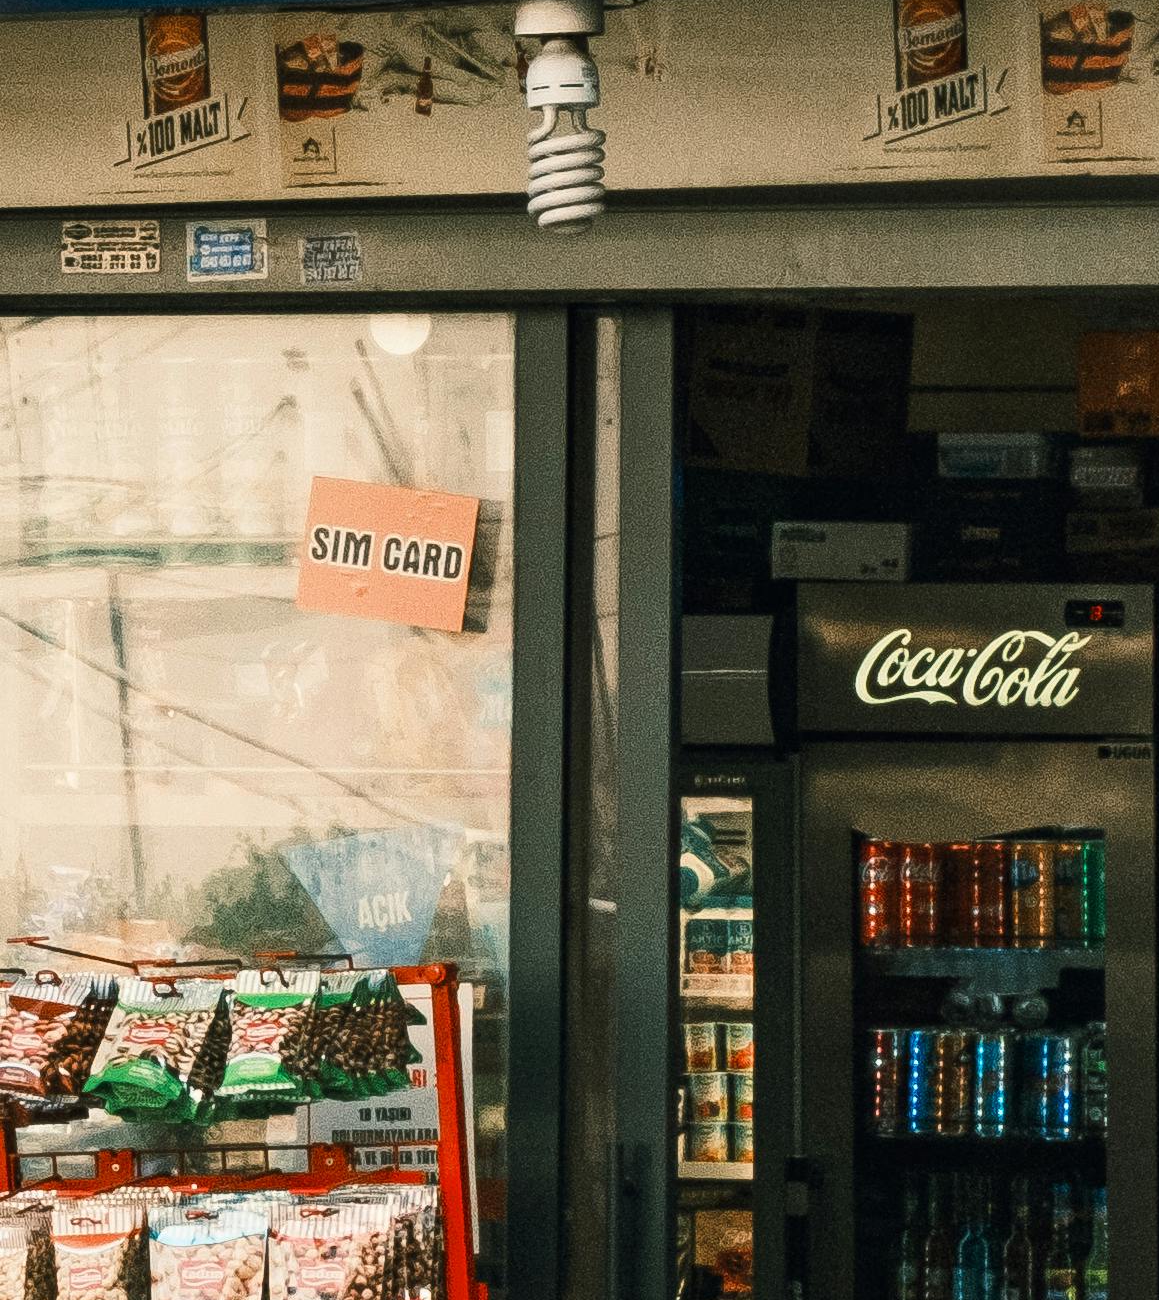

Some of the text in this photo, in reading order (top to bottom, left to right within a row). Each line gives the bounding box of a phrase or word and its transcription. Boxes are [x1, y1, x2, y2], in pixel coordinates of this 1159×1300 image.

[137, 101, 221, 157] %100 MALT
[888, 74, 979, 130] %100 MALT
[311, 527, 463, 579] SIM CARD
[358, 890, 412, 932] AÇIK
